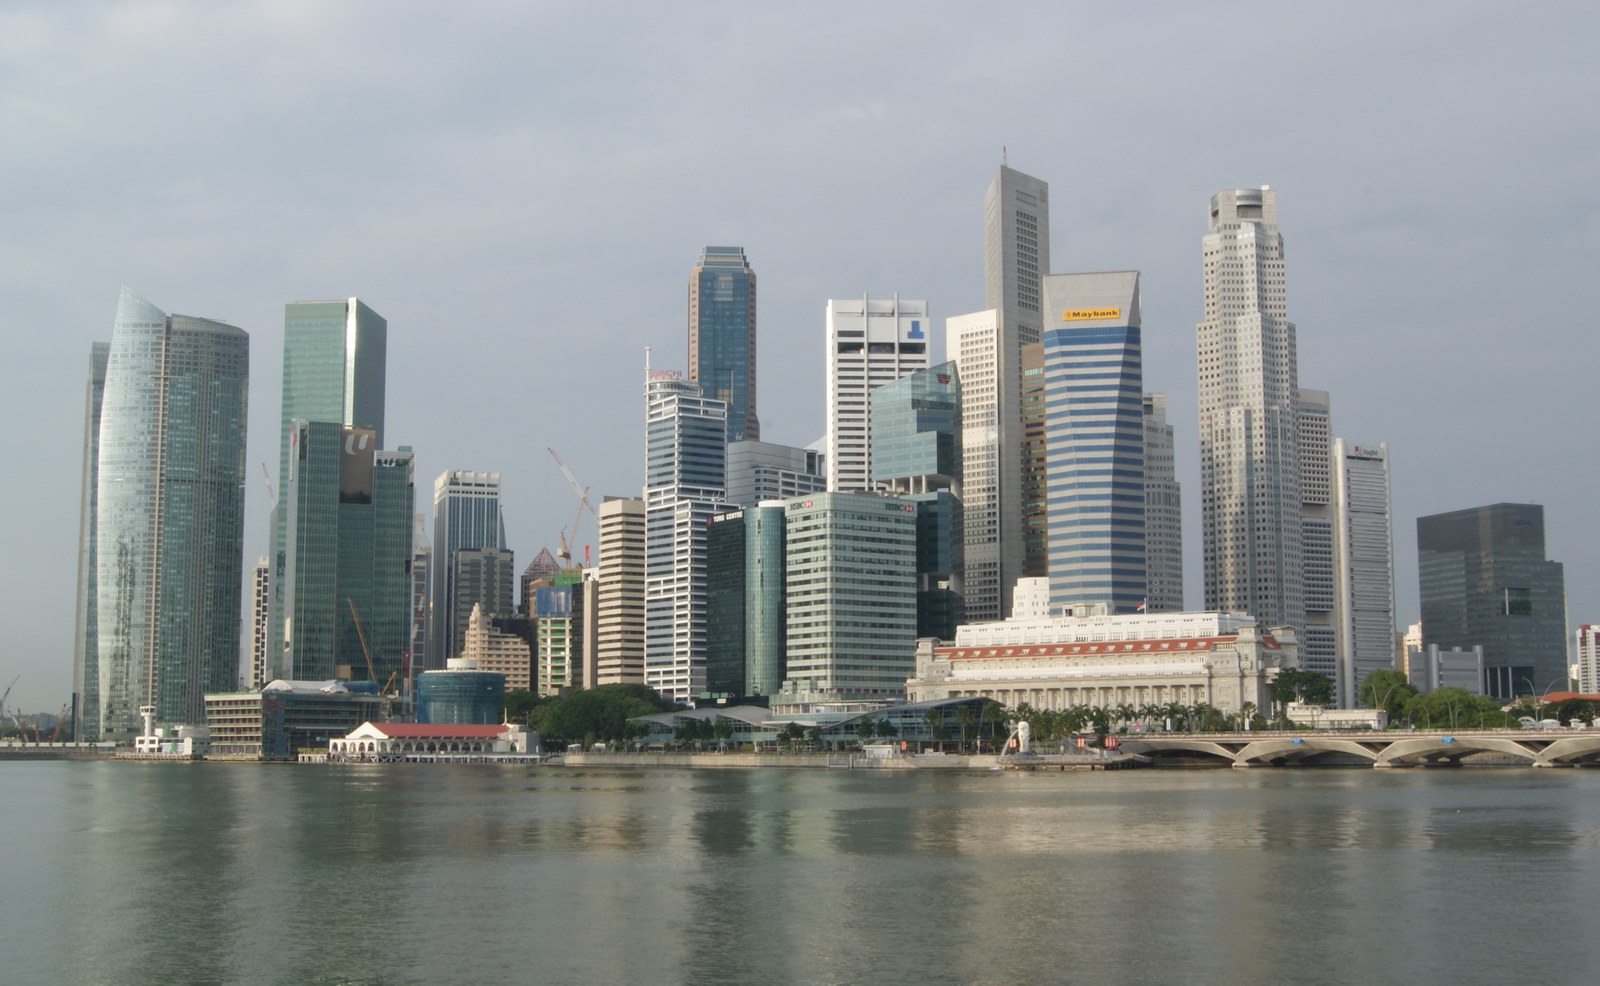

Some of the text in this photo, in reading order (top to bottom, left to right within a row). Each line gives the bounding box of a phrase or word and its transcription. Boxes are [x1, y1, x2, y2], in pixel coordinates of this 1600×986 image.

[1072, 310, 1118, 318] Maybank
[789, 502, 804, 511] HSBC
[885, 503, 904, 511] HSBC
